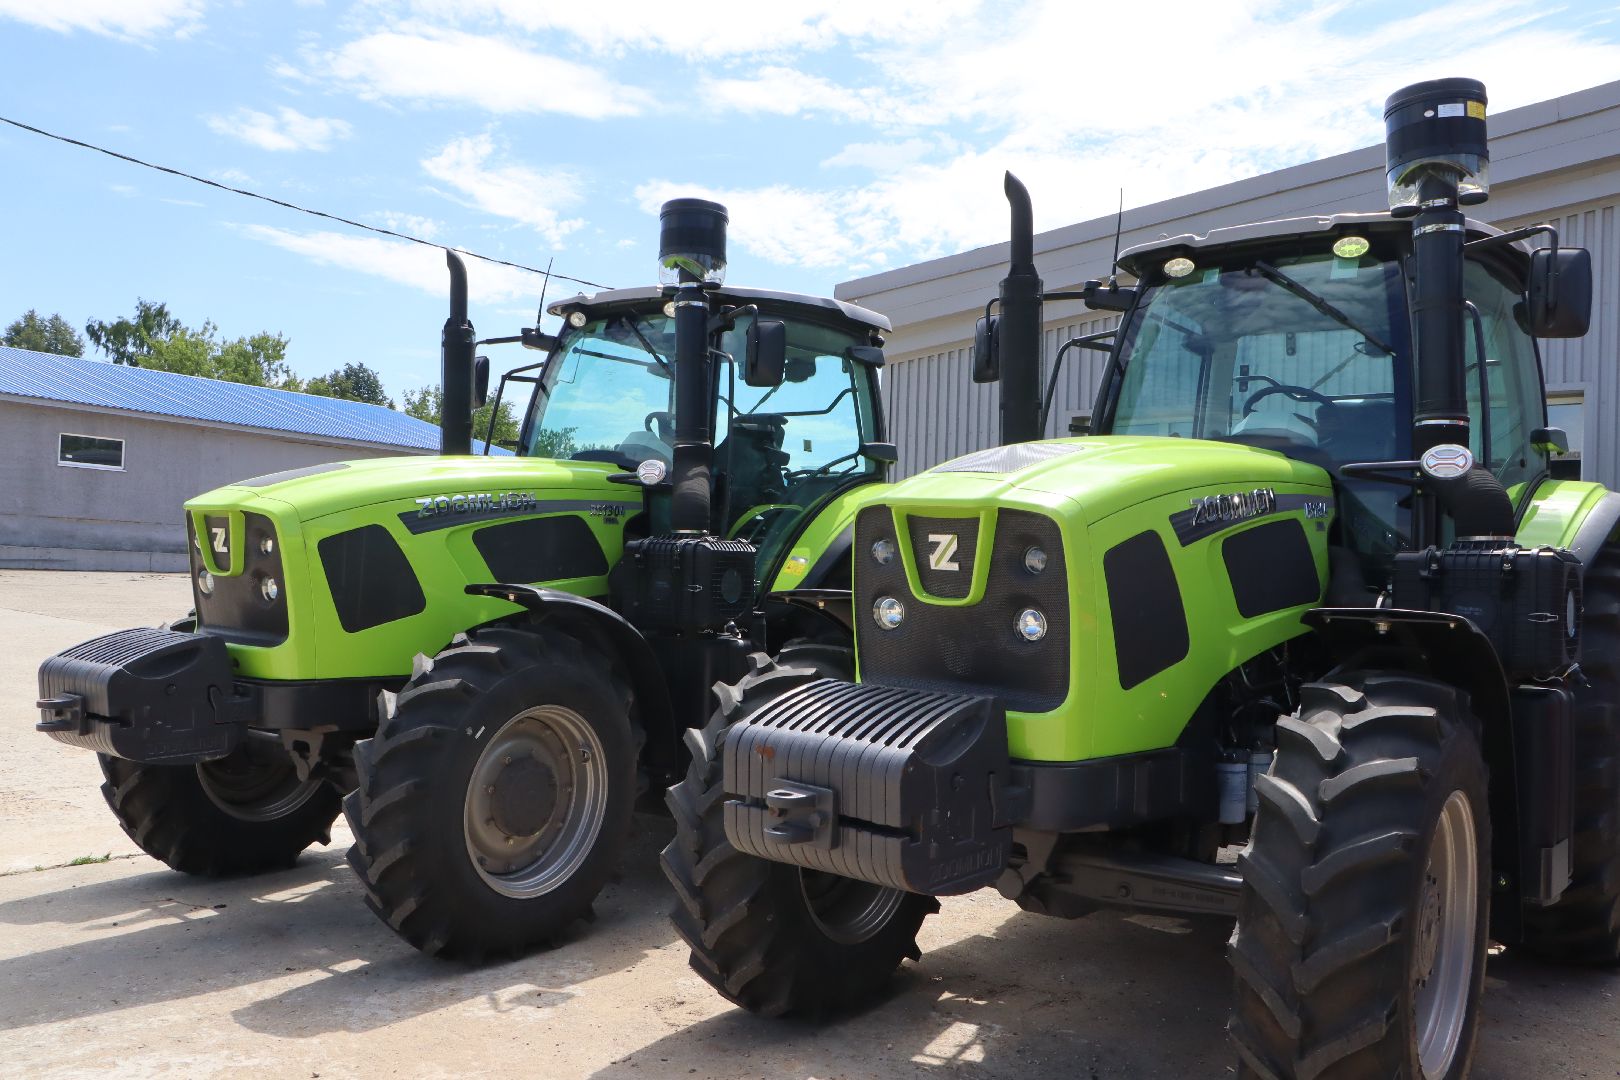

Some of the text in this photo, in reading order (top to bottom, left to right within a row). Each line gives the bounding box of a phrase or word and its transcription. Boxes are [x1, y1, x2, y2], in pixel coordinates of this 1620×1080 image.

[415, 491, 537, 518] ZOOMLION
[1189, 487, 1276, 526] ZOOMLION
[211, 527, 228, 553] Z
[928, 534, 960, 571] Z
